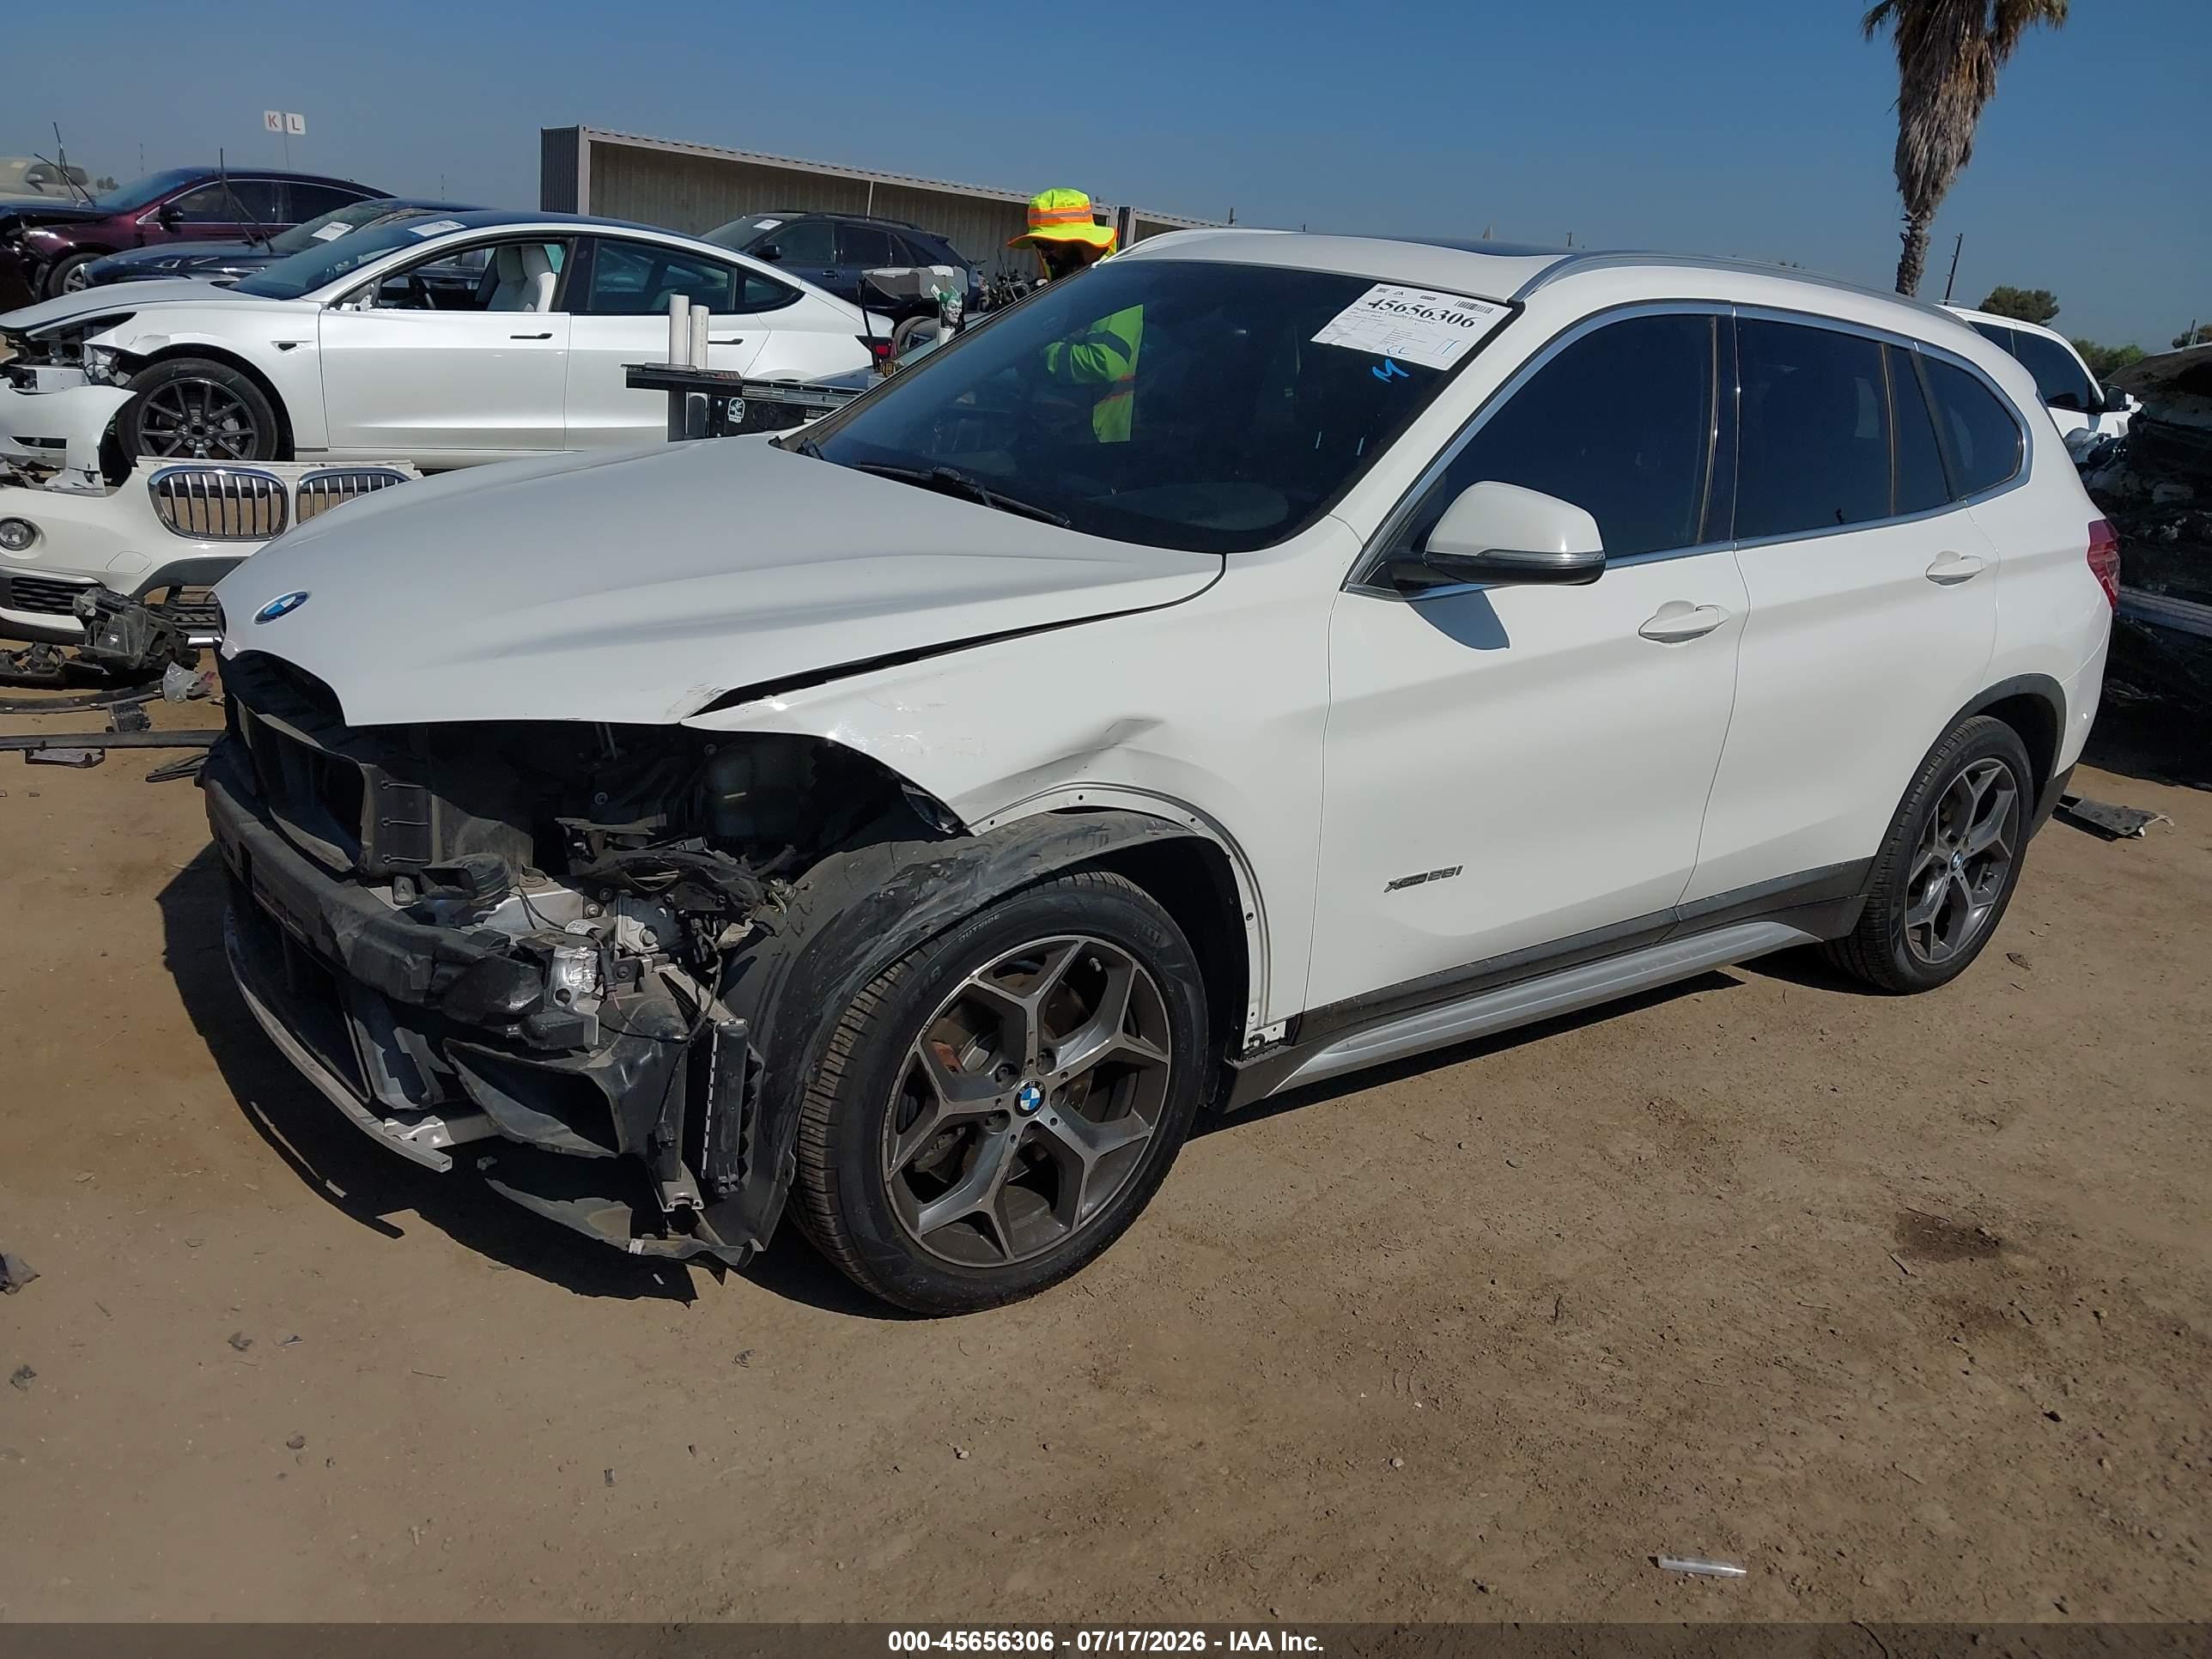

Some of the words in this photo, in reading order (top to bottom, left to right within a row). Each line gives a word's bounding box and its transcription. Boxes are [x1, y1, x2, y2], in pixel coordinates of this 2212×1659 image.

[267, 113, 278, 128] K
[291, 116, 301, 131] L
[1367, 298, 1480, 329] 45656306
[1372, 358, 1410, 383] M
